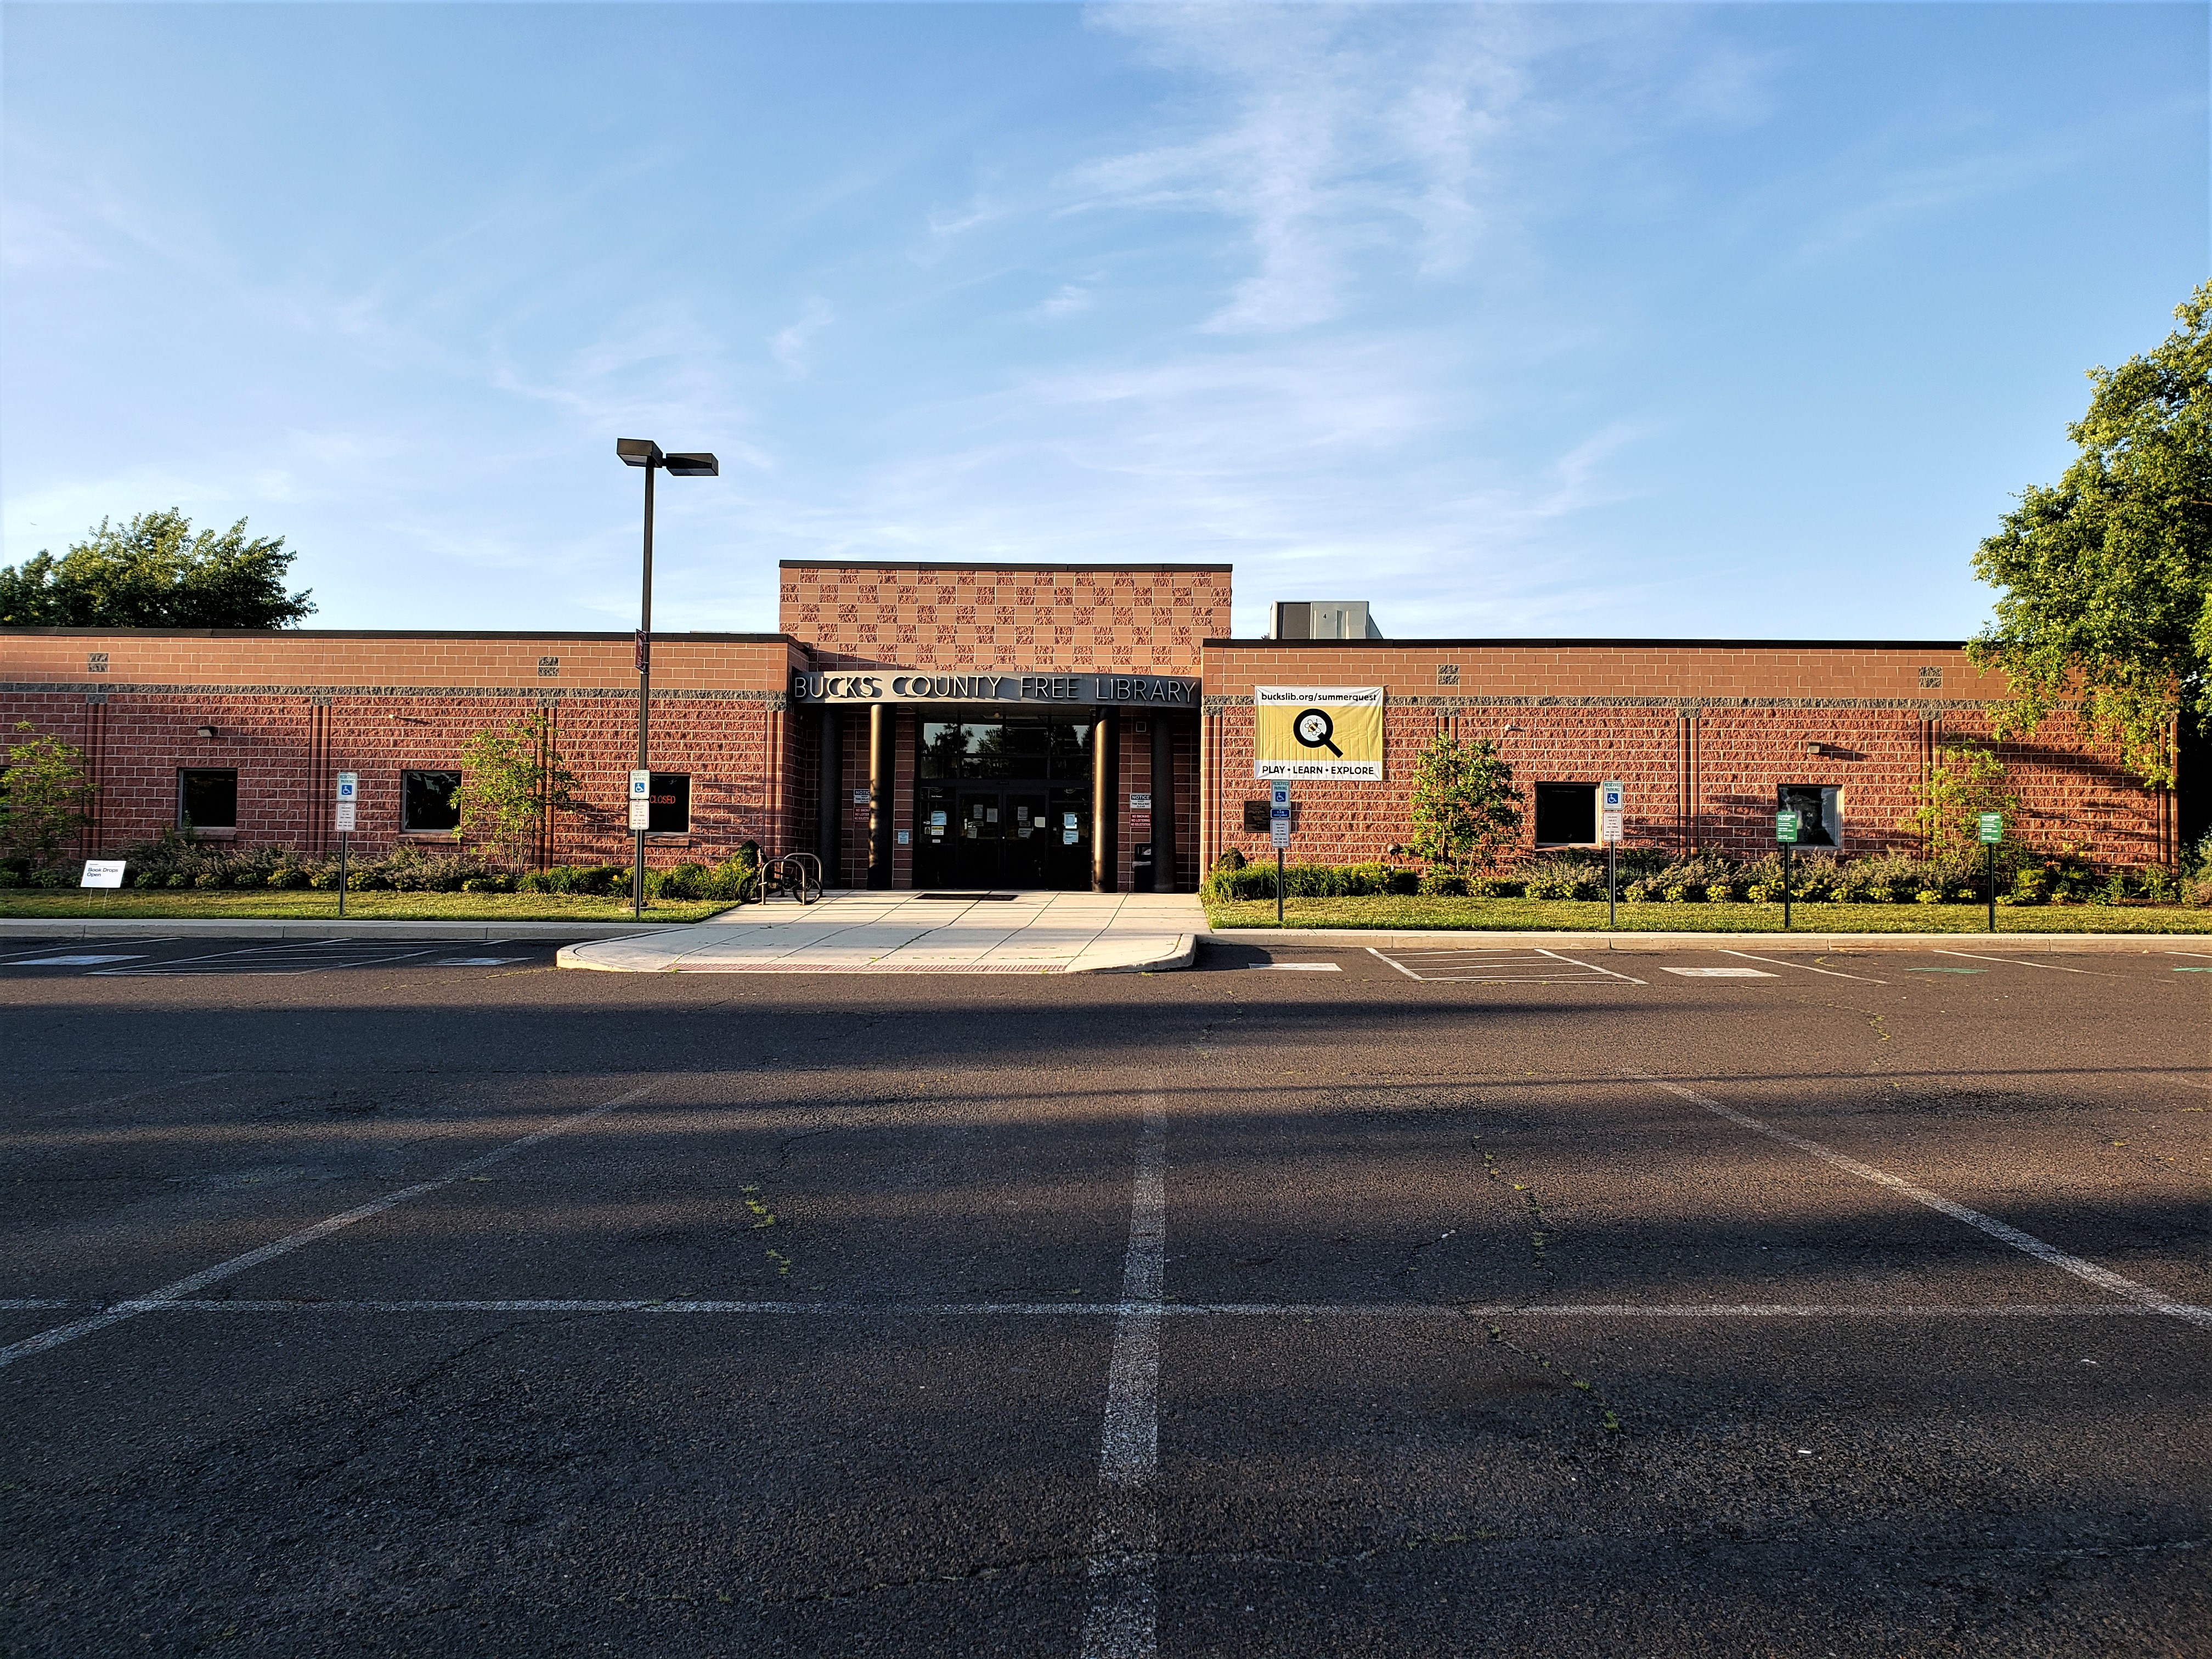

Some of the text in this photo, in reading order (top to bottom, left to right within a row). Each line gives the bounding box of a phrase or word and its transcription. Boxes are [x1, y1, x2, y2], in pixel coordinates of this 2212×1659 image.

[795, 675, 1197, 703] BUCKS COUNTY FREE LIBRARY
[1261, 692, 1377, 702] buckslib.org/summerquest
[1262, 765, 1374, 775] PLAY LEARN EXPLORE
[650, 795, 676, 804] CLOSED
